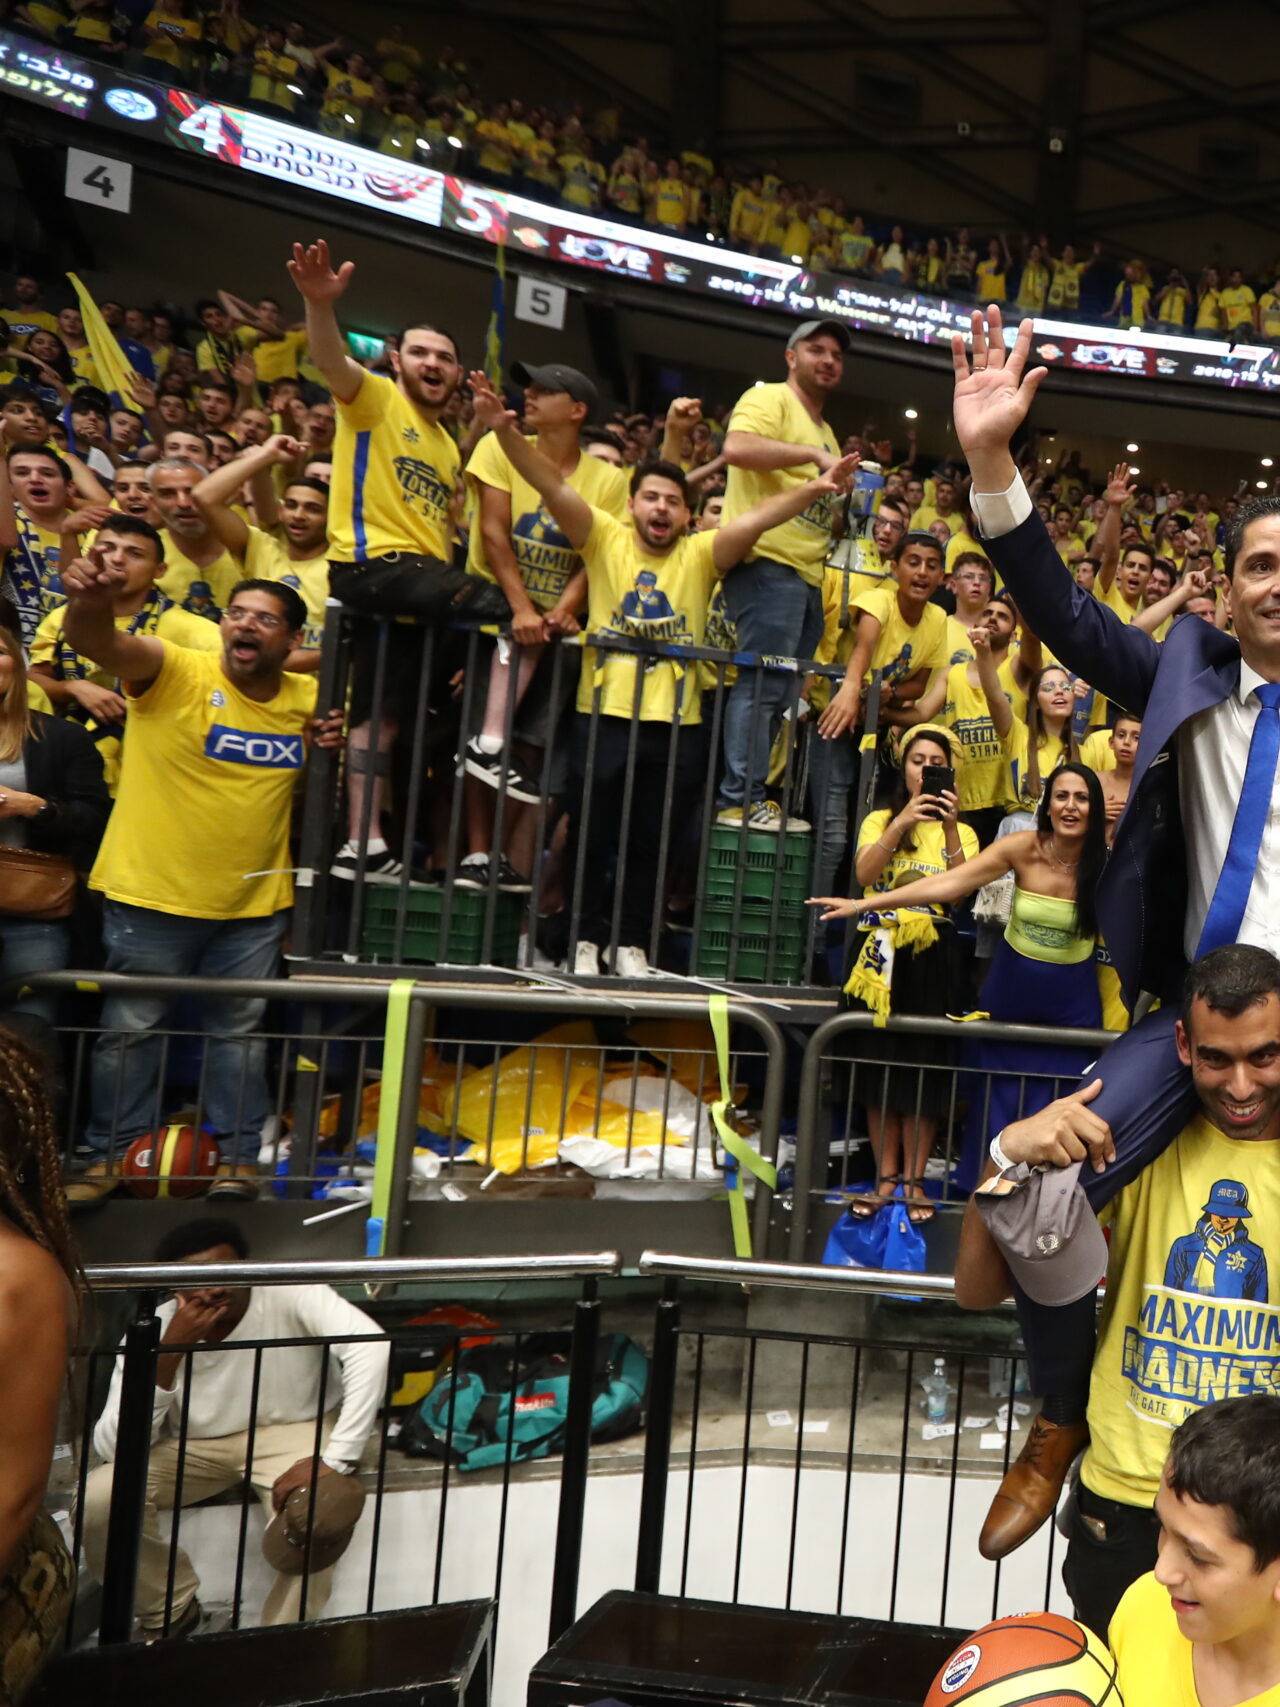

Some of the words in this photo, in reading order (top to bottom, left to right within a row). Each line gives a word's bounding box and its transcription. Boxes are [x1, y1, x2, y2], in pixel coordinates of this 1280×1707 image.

[179, 104, 226, 153] 4
[83, 165, 114, 198] 4
[455, 183, 493, 232] 5
[563, 233, 651, 272] LOVE
[530, 288, 551, 316] 5
[1075, 344, 1145, 368] LOVE
[214, 733, 299, 763] FOX
[1141, 1396, 1167, 1416] GATE
